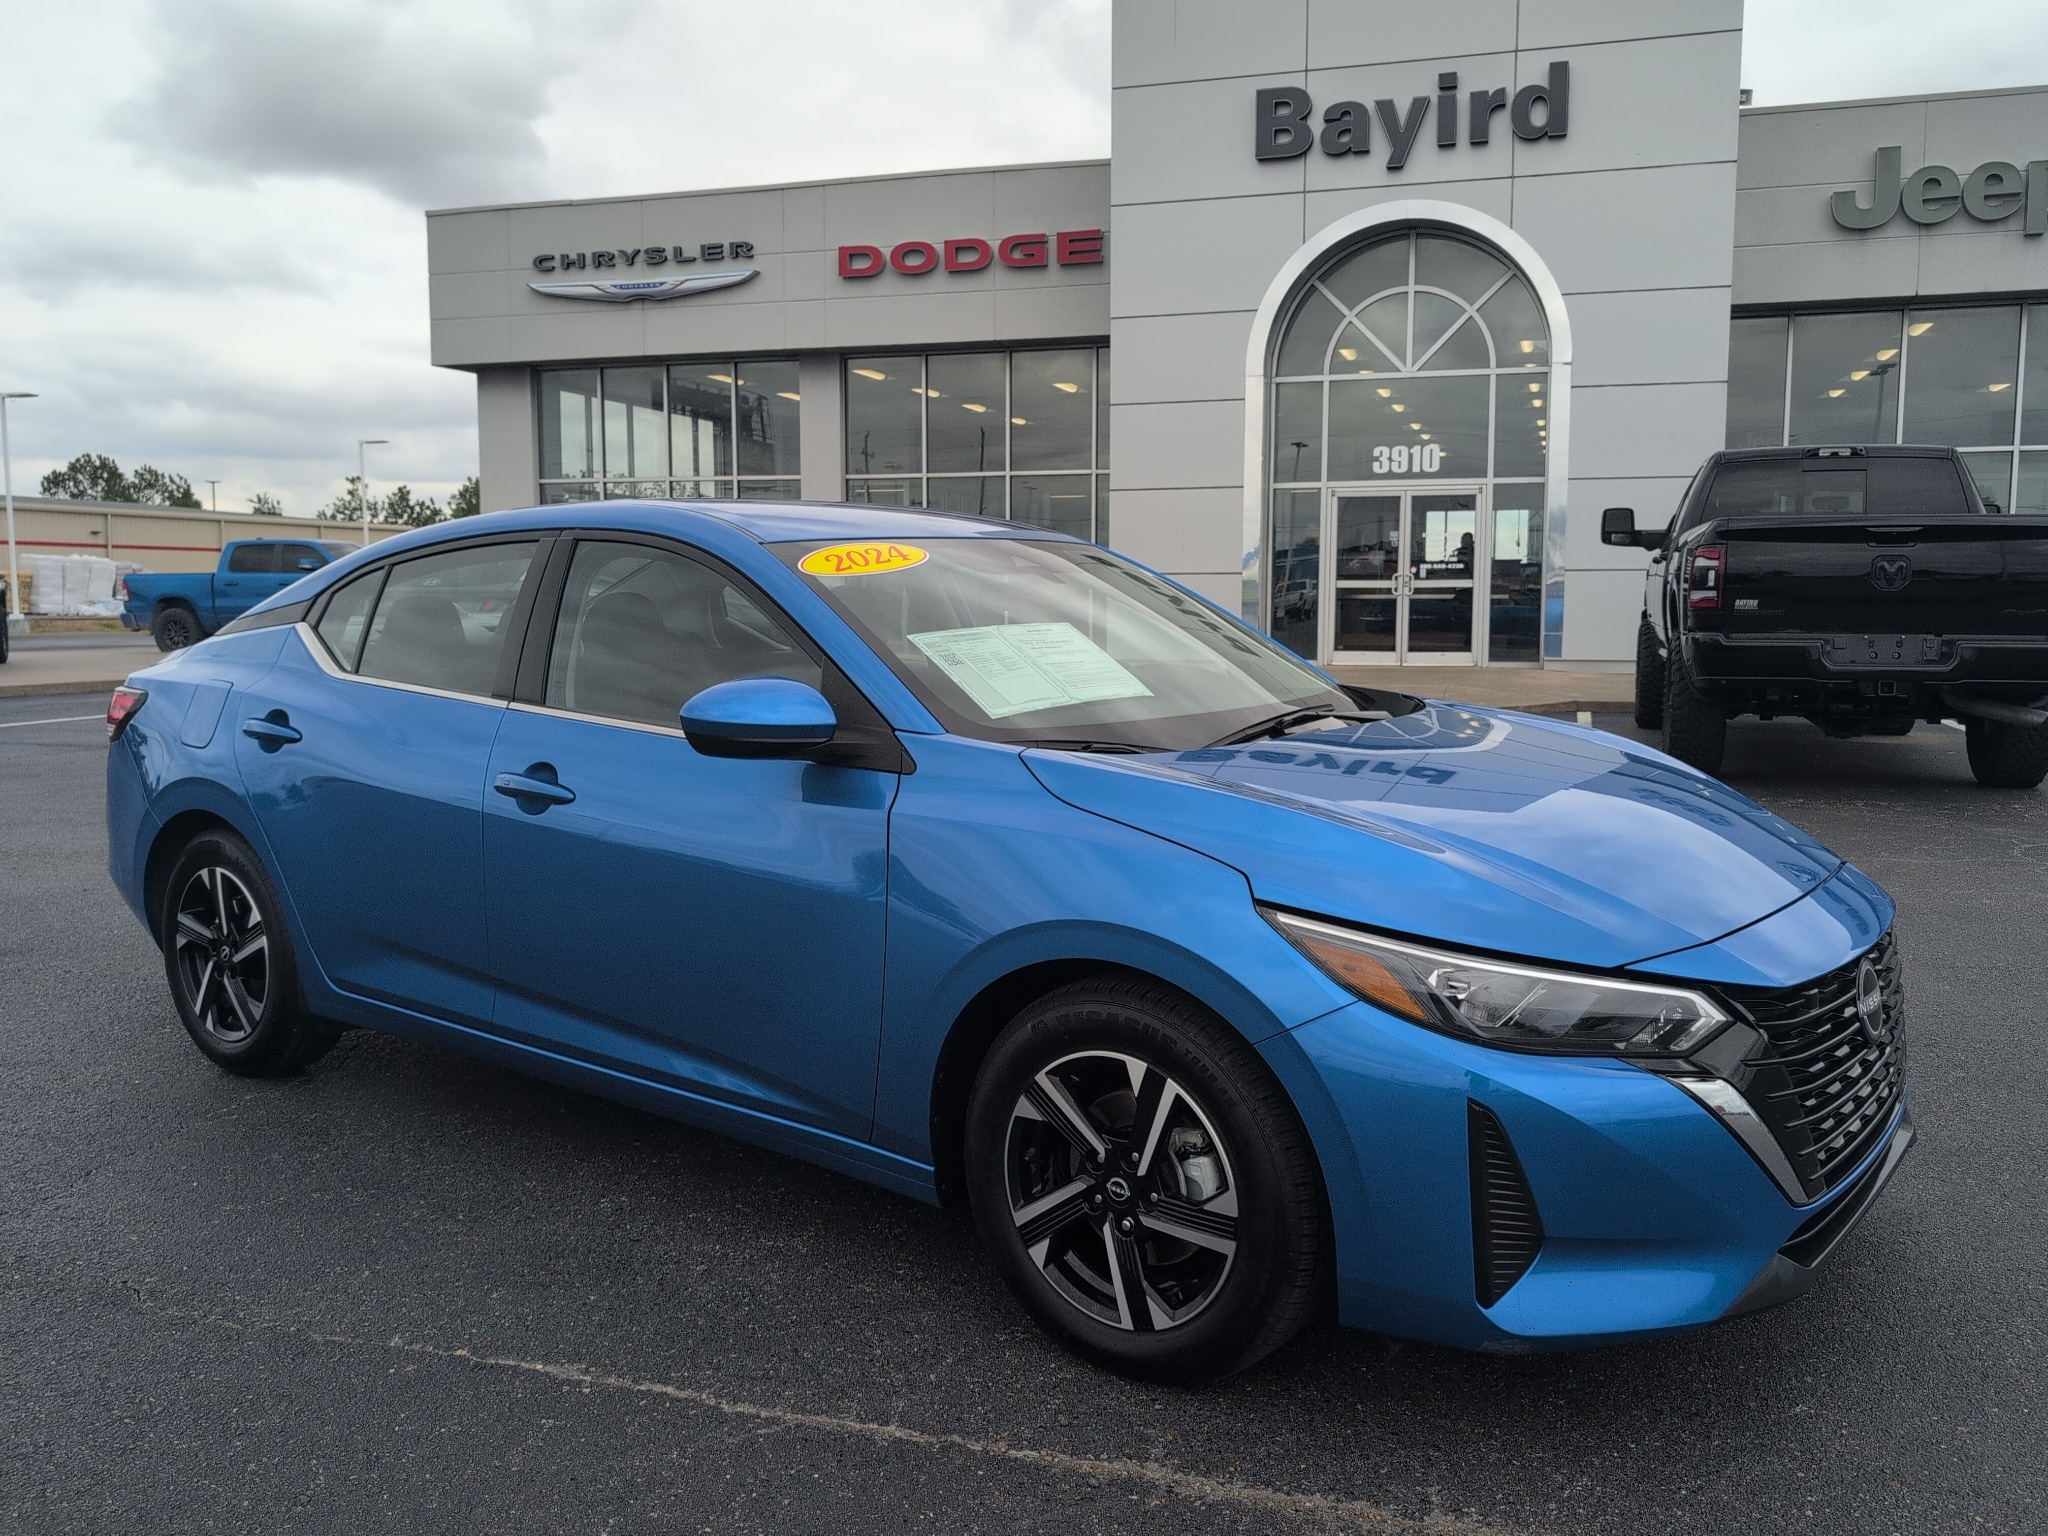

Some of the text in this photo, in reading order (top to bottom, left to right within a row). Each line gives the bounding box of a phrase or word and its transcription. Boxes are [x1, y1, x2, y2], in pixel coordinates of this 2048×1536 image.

[1255, 61, 1569, 169] Bayird
[532, 241, 754, 271] CHRYSLER
[838, 229, 1104, 279] DODGE
[1372, 443, 1441, 474] 3910
[825, 545, 911, 573] 2024
